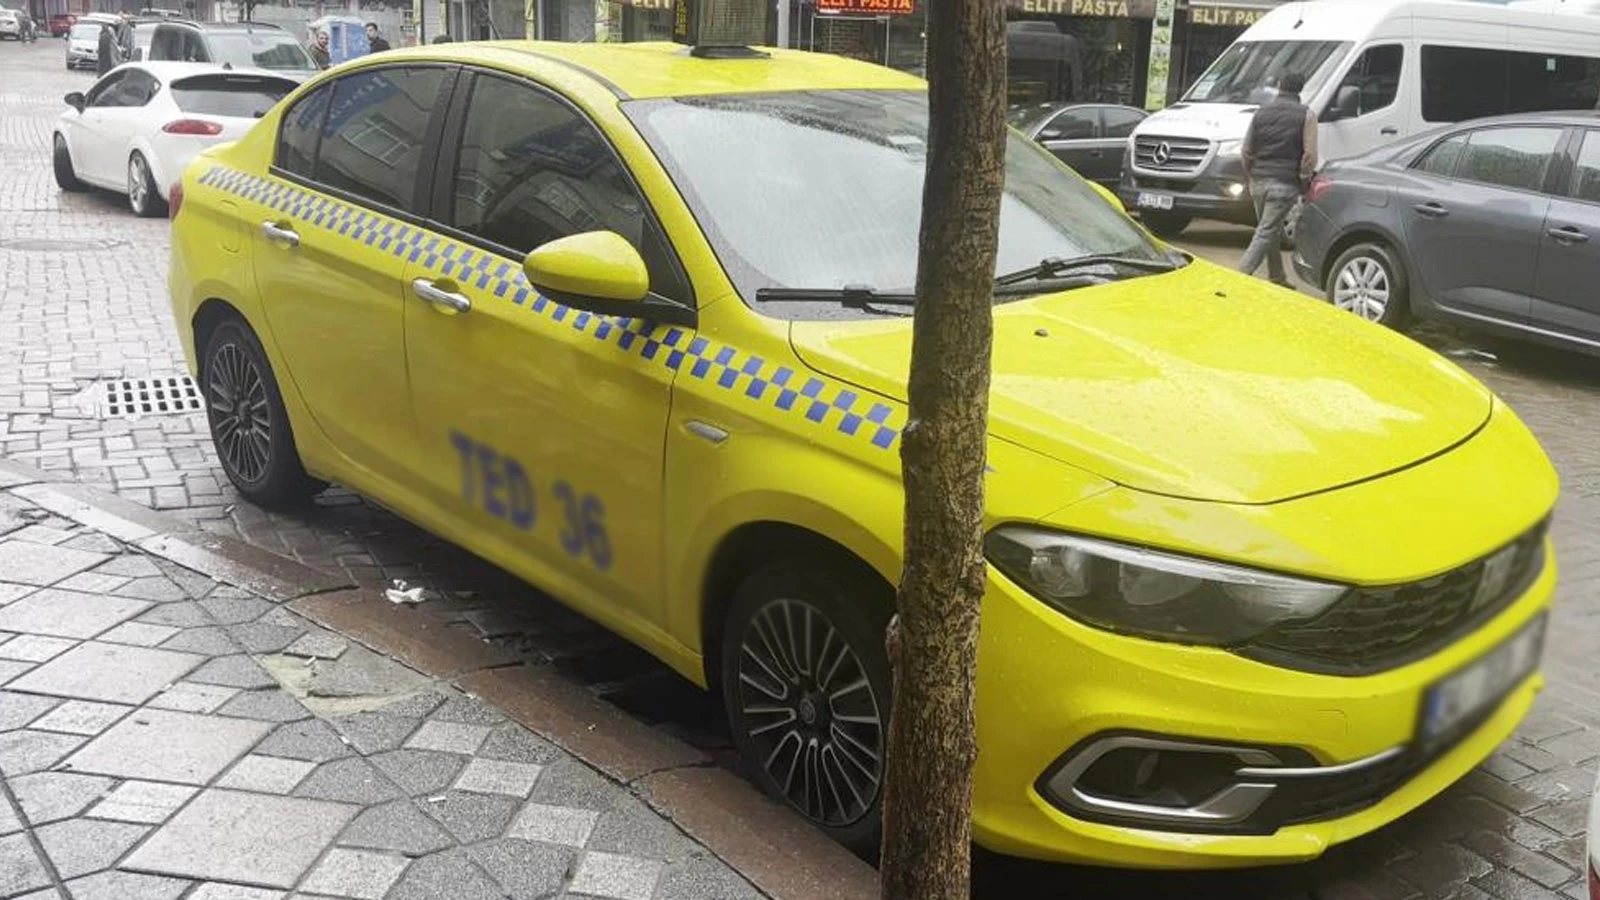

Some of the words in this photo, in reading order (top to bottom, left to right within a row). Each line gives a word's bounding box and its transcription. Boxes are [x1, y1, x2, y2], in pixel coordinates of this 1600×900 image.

[1071, 0, 1129, 17] PASTA
[448, 429, 536, 531] TED
[552, 479, 614, 572] 36
